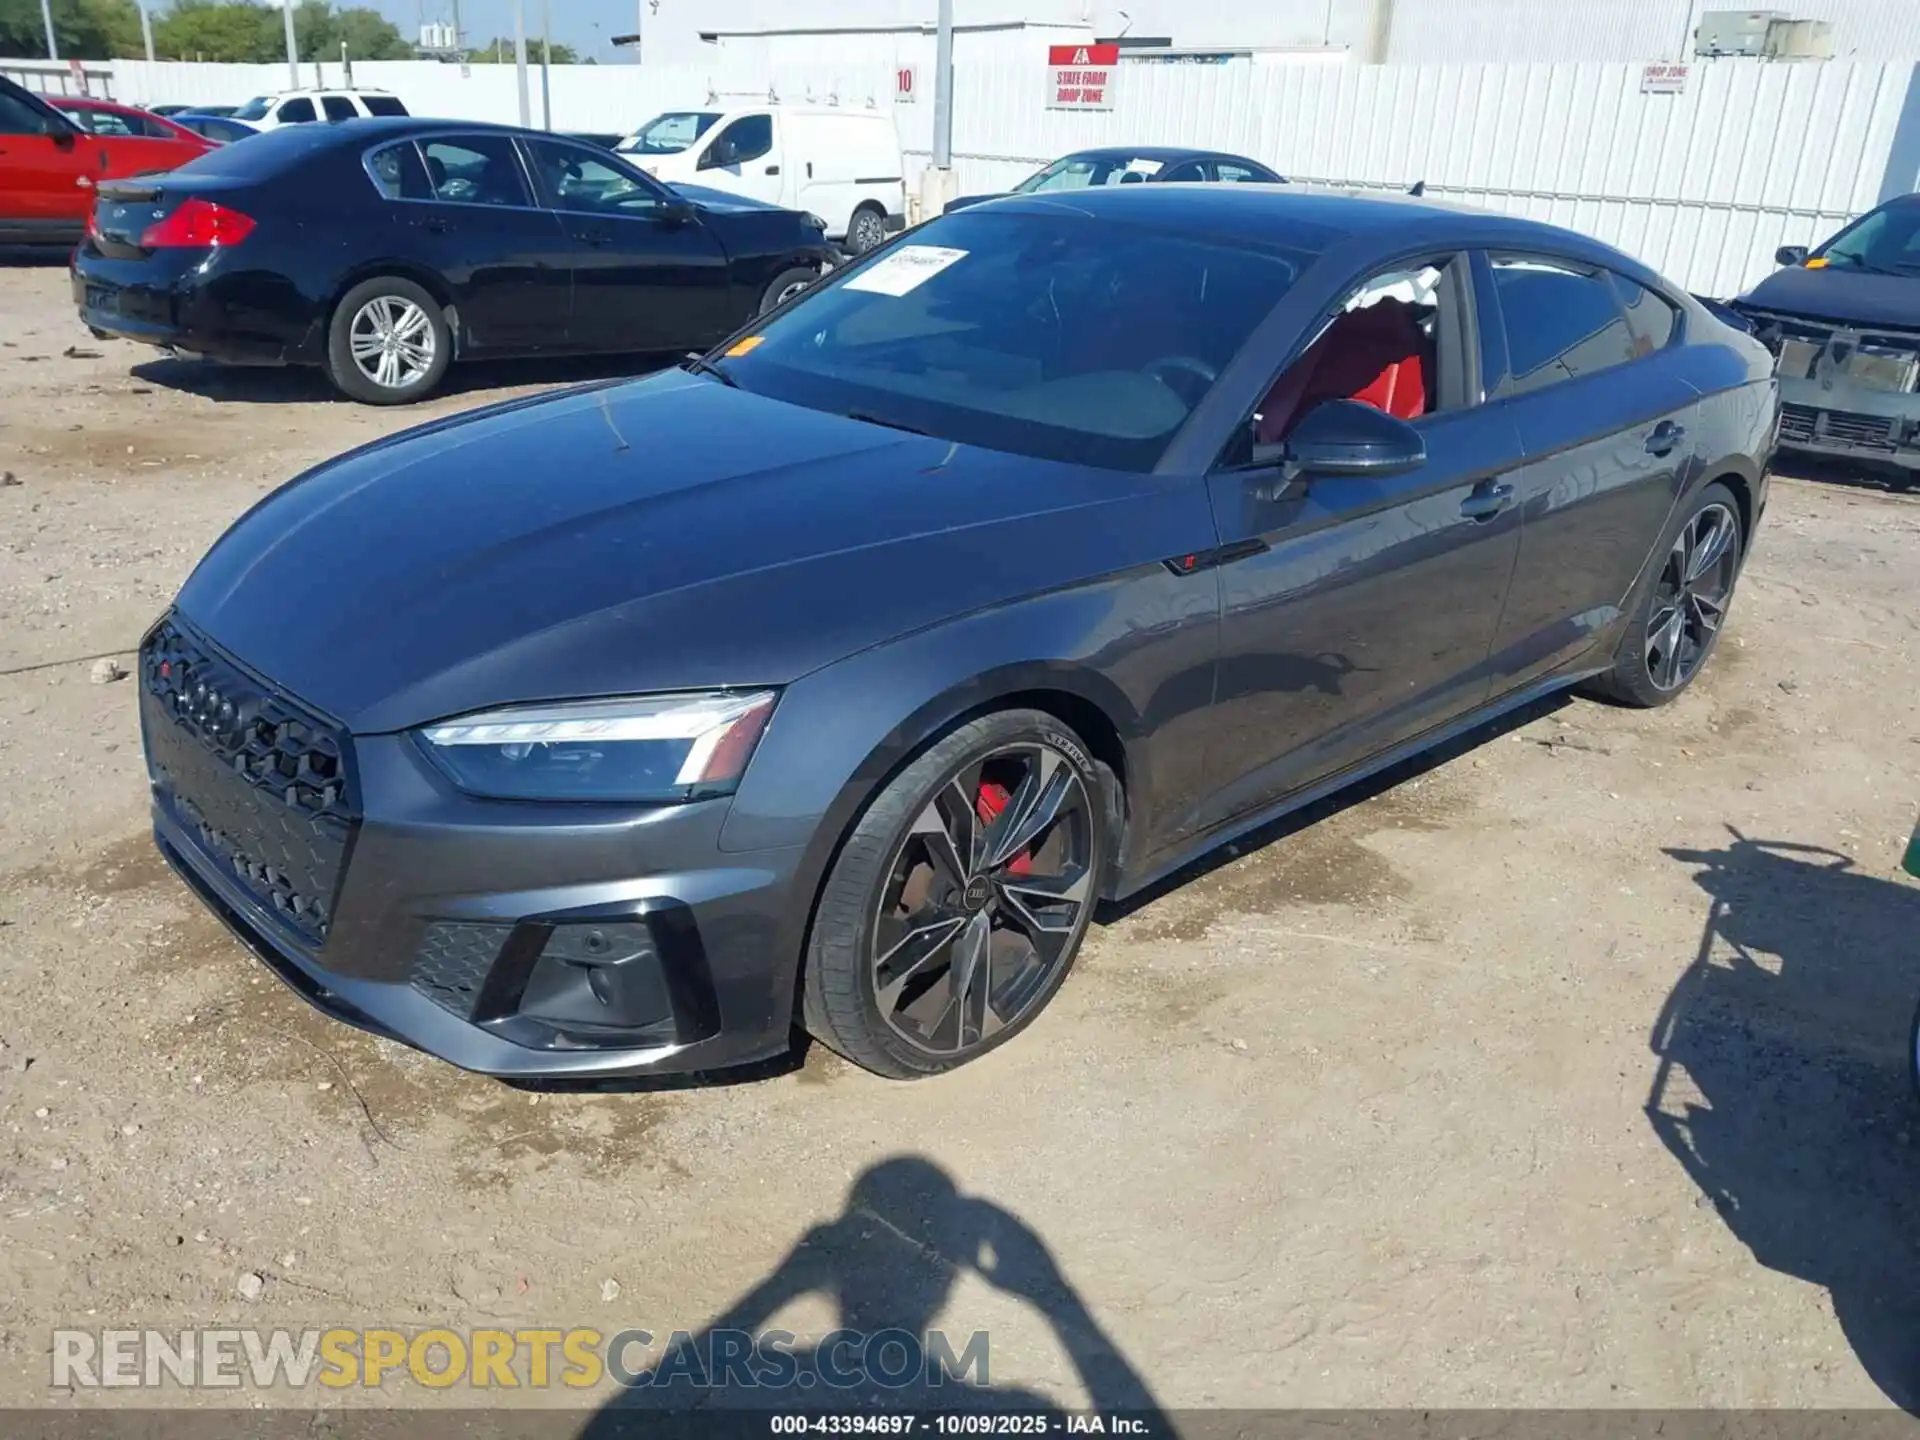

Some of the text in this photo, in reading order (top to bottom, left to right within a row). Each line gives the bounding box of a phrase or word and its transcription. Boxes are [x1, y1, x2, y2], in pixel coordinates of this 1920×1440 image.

[897, 69, 912, 93] 10
[1056, 71, 1107, 85] STATE FARM
[1056, 87, 1104, 103] DROP ZONE
